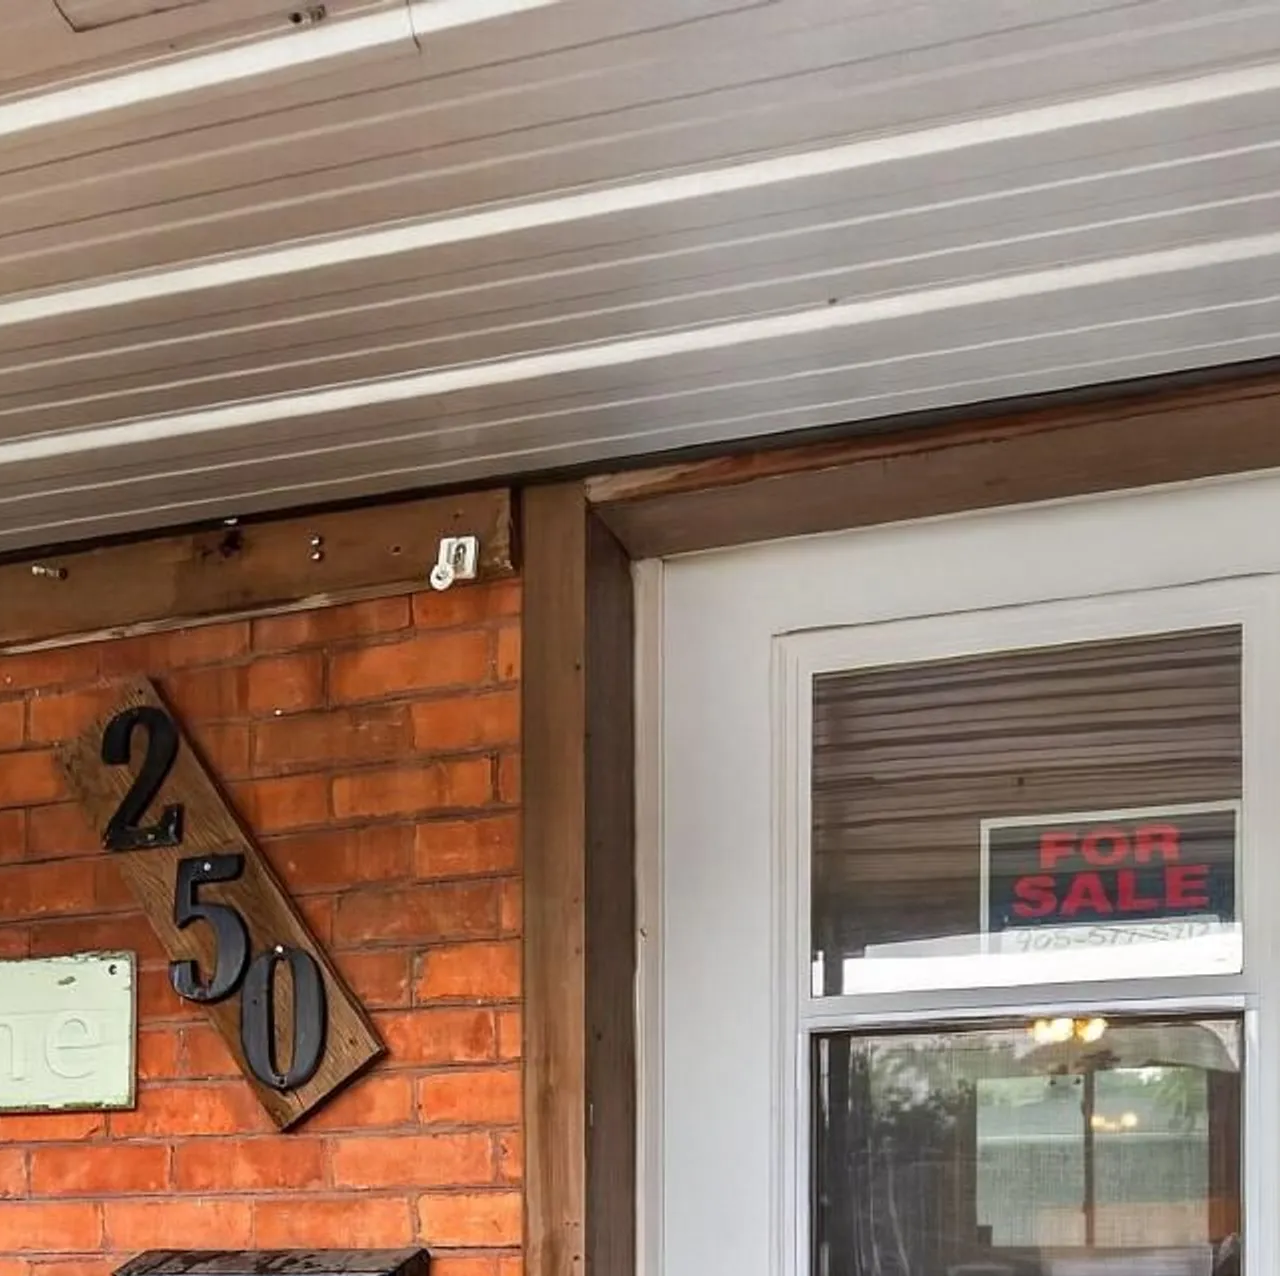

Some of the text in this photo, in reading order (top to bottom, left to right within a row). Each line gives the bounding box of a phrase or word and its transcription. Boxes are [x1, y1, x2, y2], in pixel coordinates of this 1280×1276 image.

[1040, 823, 1180, 869] FOR
[102, 706, 328, 1091] 250
[1013, 865, 1210, 917] SALE
